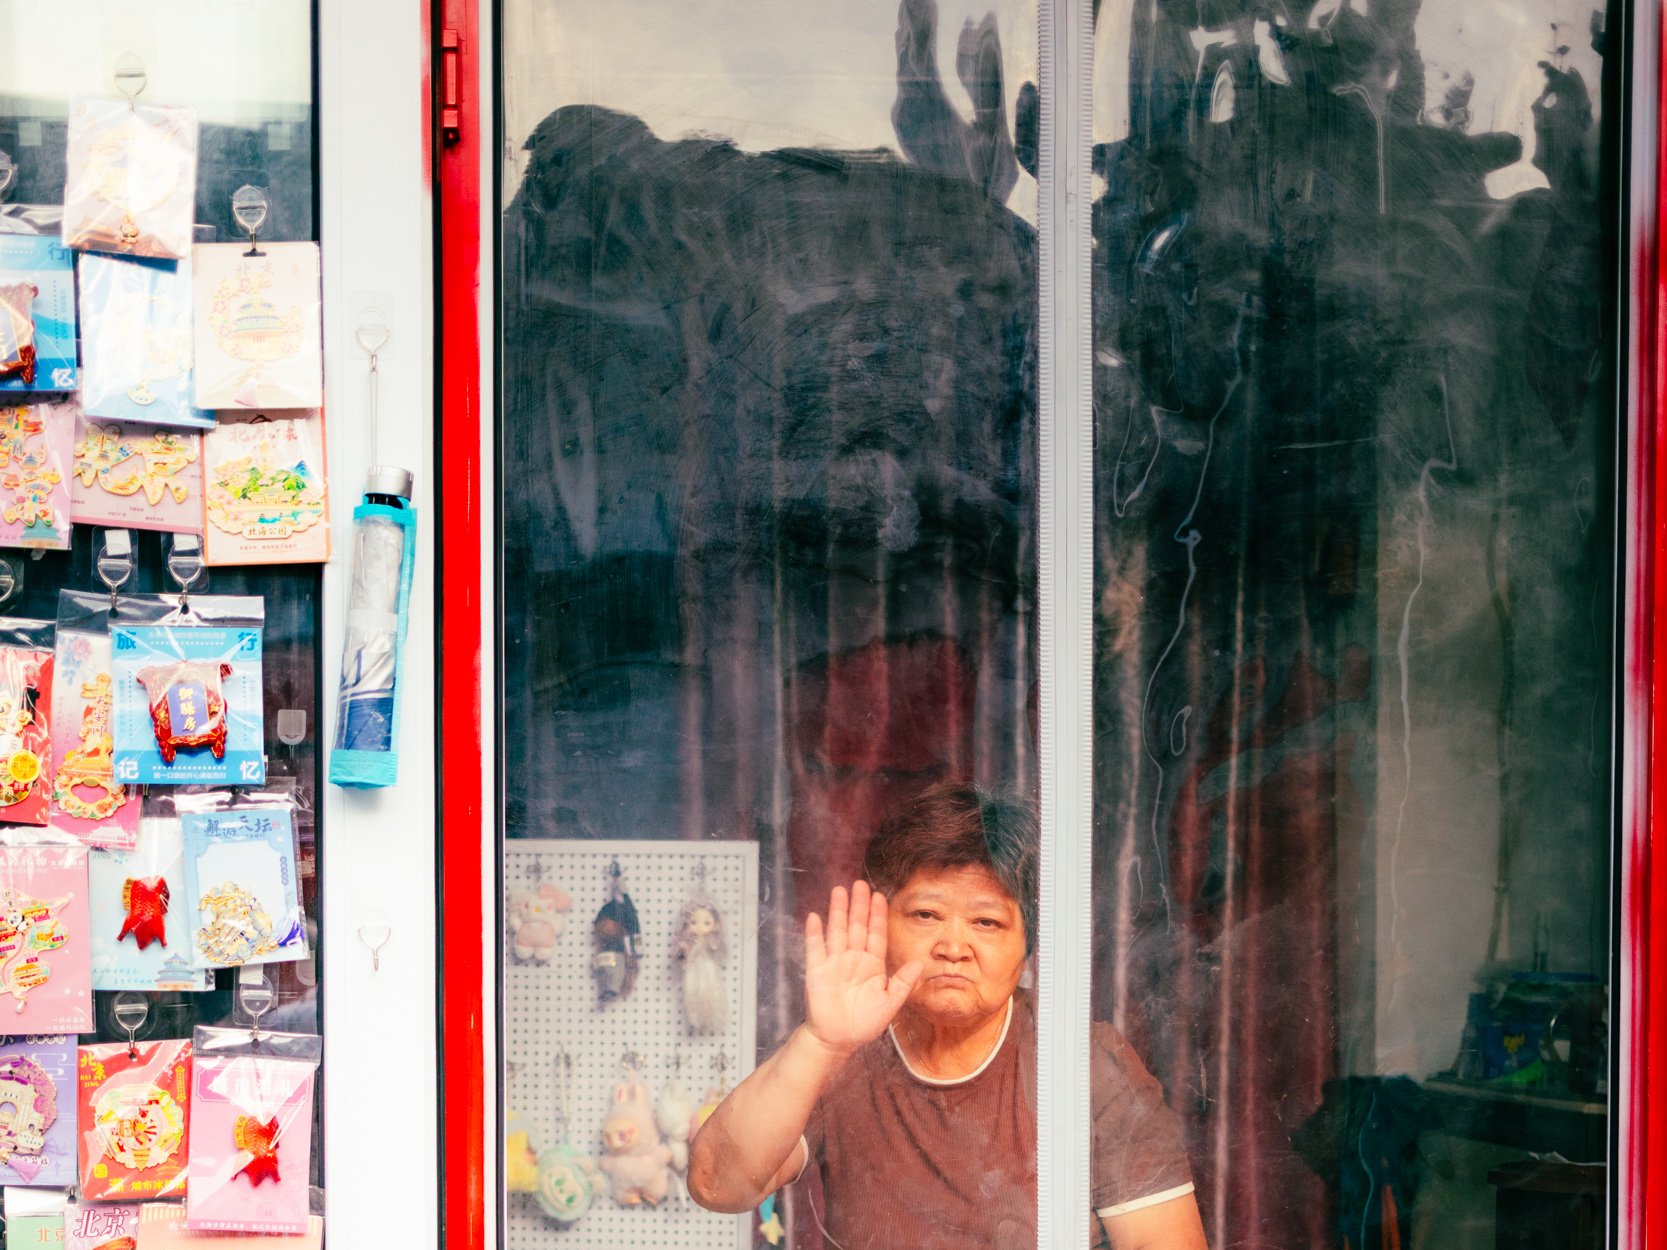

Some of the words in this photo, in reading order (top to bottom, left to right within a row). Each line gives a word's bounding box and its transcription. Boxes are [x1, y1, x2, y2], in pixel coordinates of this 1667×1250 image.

[52, 368, 74, 387] 忆
[116, 630, 137, 650] 旅
[238, 631, 258, 651] 行
[117, 758, 139, 780] 记
[240, 760, 261, 781] 忆
[73, 1208, 139, 1238] 北京
